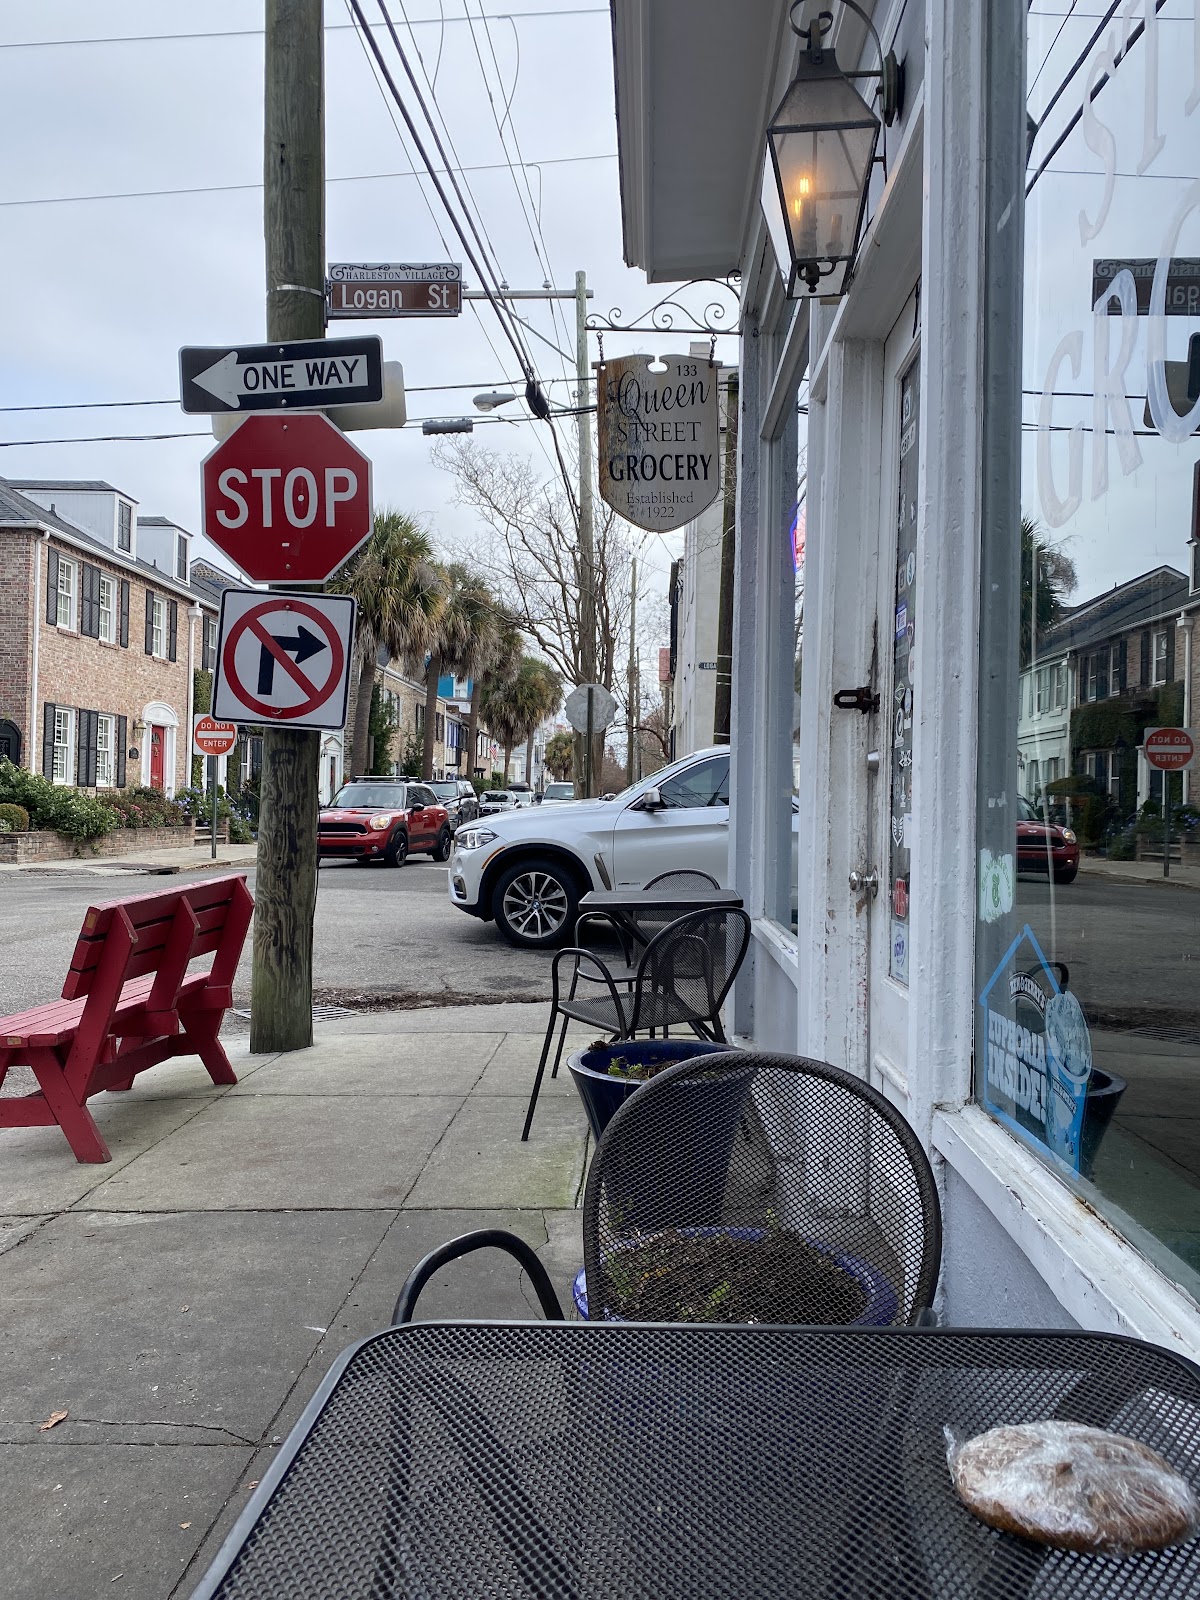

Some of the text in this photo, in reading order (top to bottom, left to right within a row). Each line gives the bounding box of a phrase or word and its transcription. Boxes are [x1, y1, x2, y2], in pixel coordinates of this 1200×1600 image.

[405, 271, 444, 280] VILLAGE
[341, 283, 450, 309] Logan St
[243, 358, 360, 390] ONE WAY
[676, 364, 698, 377] 133
[607, 370, 711, 432] Queen
[617, 421, 702, 442] STREET
[609, 454, 712, 482] GROCERY
[216, 466, 358, 529] STOP
[626, 491, 694, 504] Established
[647, 506, 675, 518] 1922
[988, 1009, 1047, 1073] EUPHORIA
[987, 1042, 1047, 1125] INSIDE!
